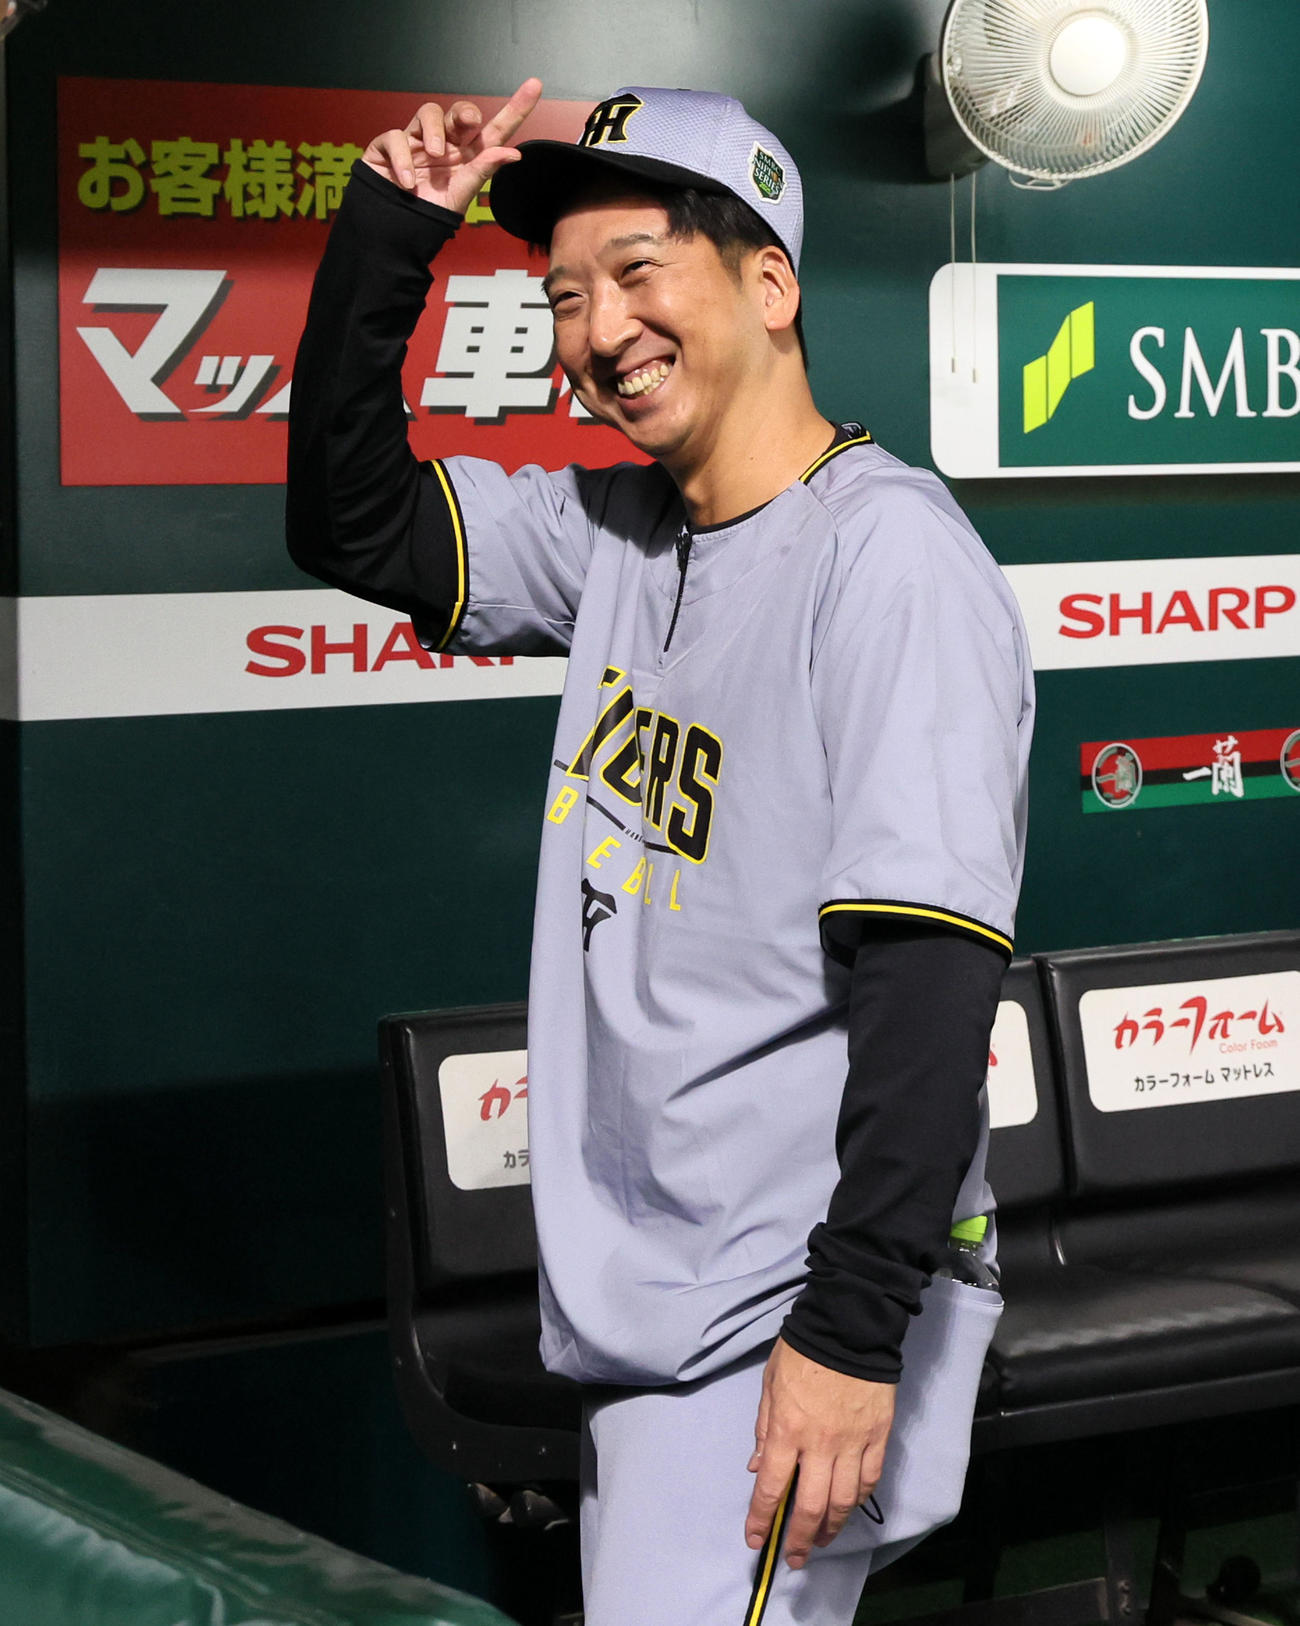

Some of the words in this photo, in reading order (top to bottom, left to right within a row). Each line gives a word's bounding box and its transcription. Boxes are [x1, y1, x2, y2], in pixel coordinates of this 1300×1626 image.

[77, 135, 494, 222] お客様満
[76, 267, 594, 418] マッ車
[1058, 585, 1296, 639] SHARP
[244, 622, 514, 678] SHA
[1182, 735, 1245, 798] 一蘭
[1113, 995, 1285, 1055] カラーフォーム
[1219, 1042, 1248, 1054] Color
